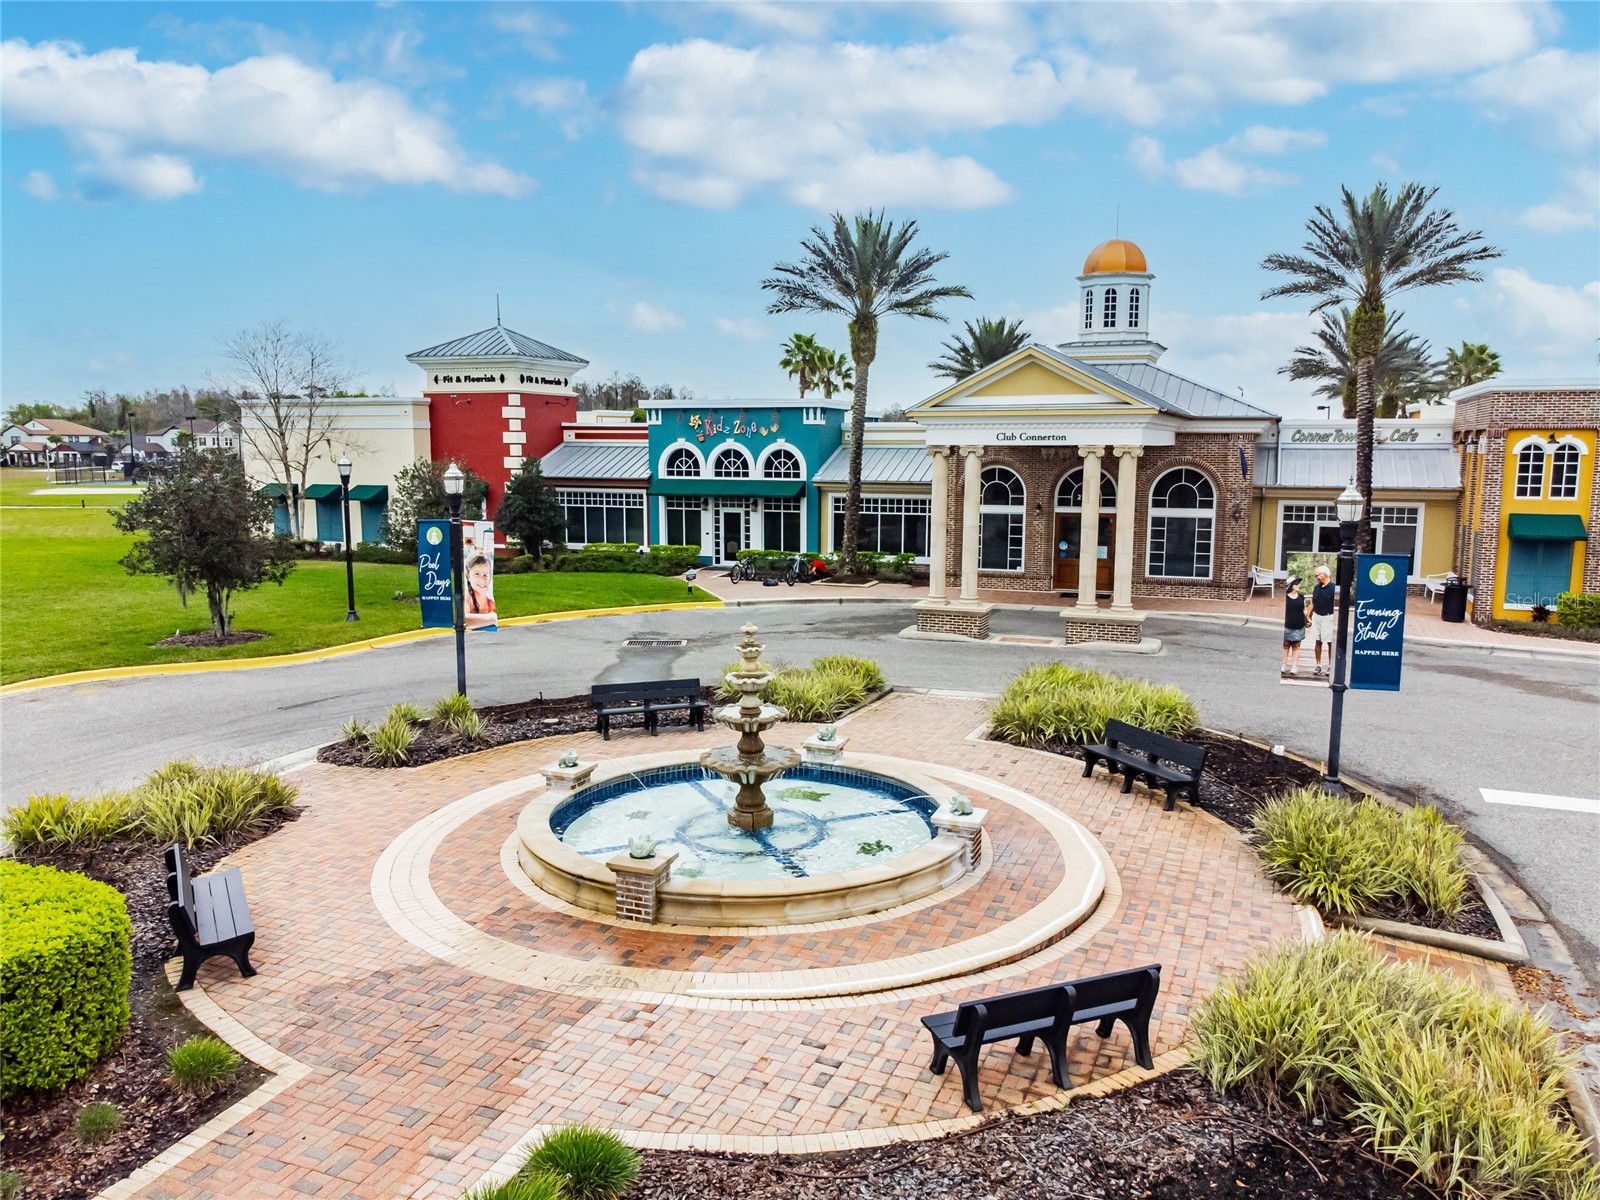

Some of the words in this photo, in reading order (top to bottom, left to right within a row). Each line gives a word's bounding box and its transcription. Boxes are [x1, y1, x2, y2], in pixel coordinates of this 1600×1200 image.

[443, 375, 453, 383] Fit
[464, 374, 496, 383] Flourish
[541, 377, 562, 386] Flourish
[704, 416, 731, 437] Kidz
[733, 420, 757, 439] Zone
[996, 433, 1017, 441] Club
[1019, 433, 1067, 441] Connerton
[1291, 429, 1357, 443] ConnerTow
[1390, 428, 1419, 442] Cafe
[419, 552, 441, 573] Pool
[424, 571, 451, 595] Days
[1356, 599, 1402, 628] Evening
[1354, 621, 1389, 642] Strolls
